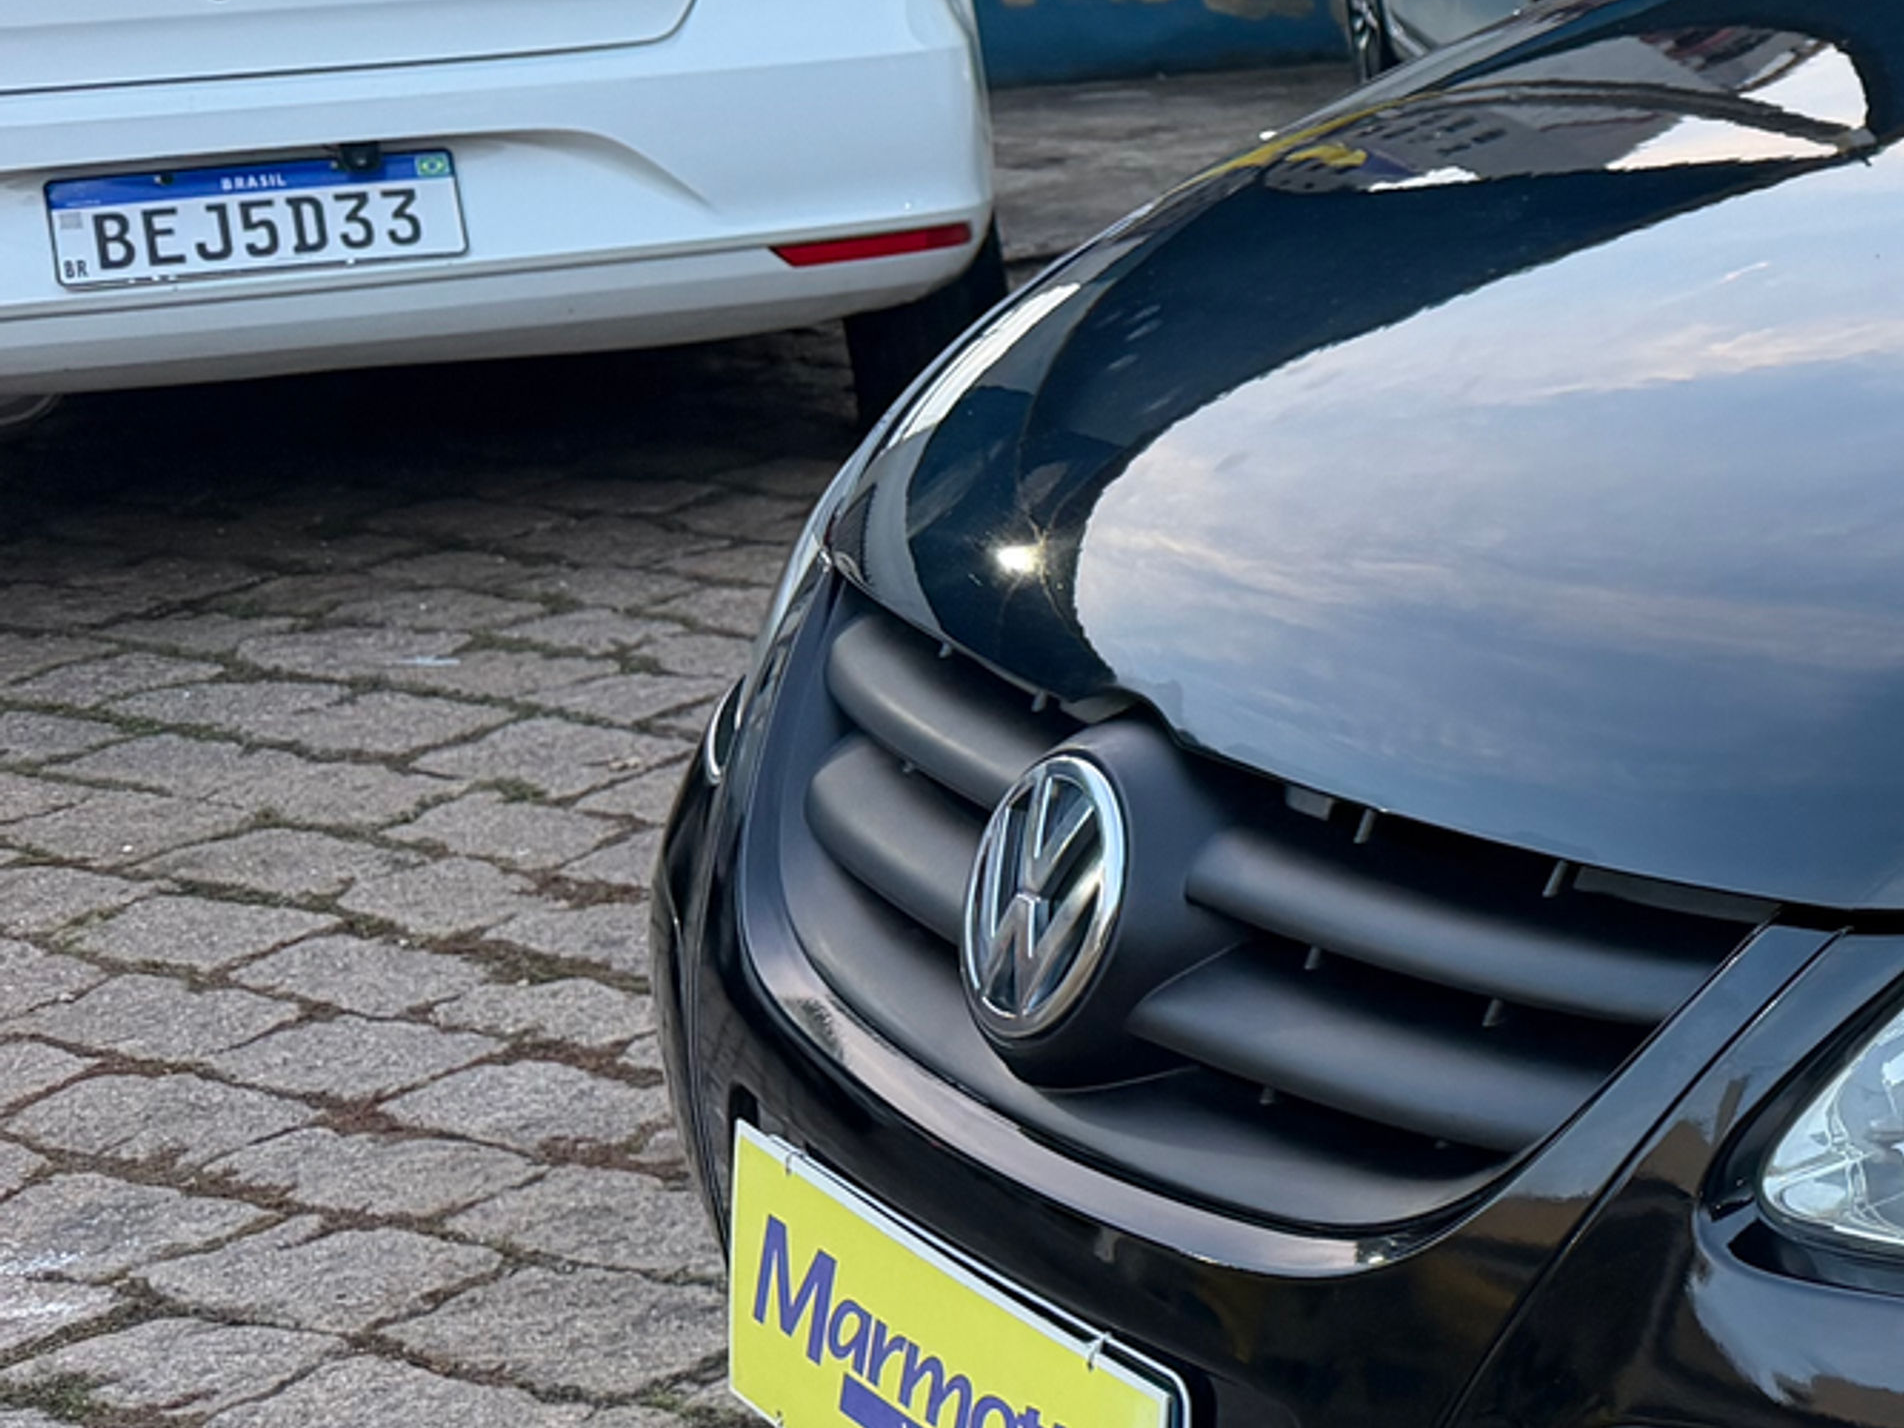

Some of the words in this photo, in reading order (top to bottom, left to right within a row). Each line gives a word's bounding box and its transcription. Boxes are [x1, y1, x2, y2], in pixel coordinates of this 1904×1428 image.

[219, 173, 288, 191] BRASIL
[92, 188, 423, 271] BEJ5D33
[63, 259, 89, 278] BR
